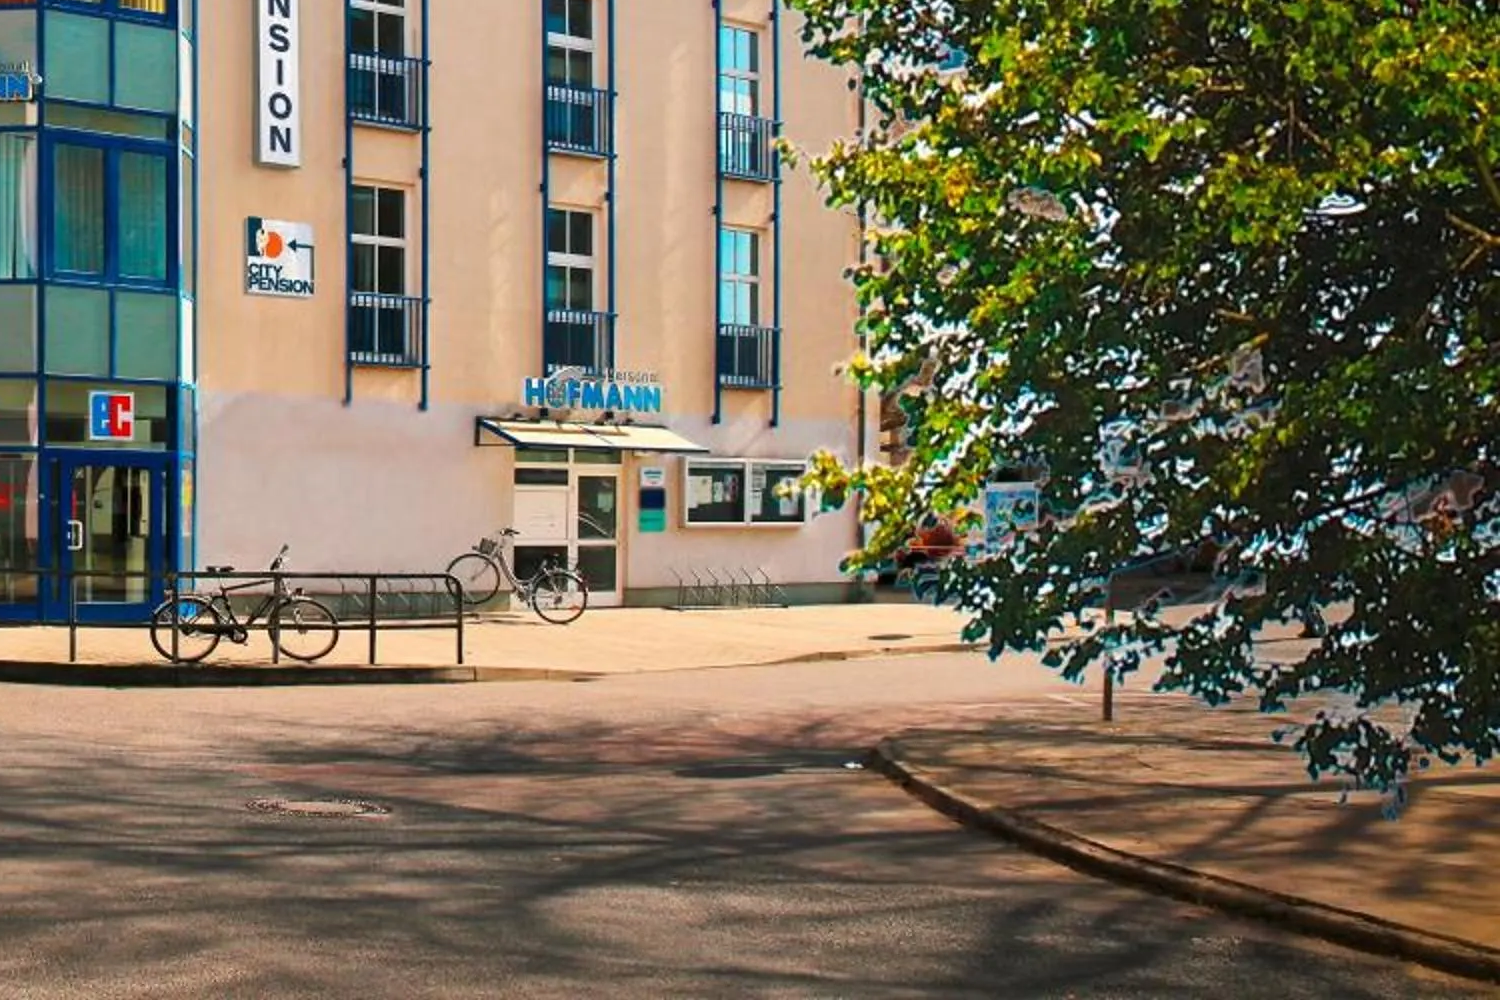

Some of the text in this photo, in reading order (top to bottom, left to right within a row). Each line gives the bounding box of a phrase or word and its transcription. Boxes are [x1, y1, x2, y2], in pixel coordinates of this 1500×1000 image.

[248, 263, 283, 278] CITY
[248, 277, 314, 294] PENSION
[525, 377, 661, 412] HOFMANN
